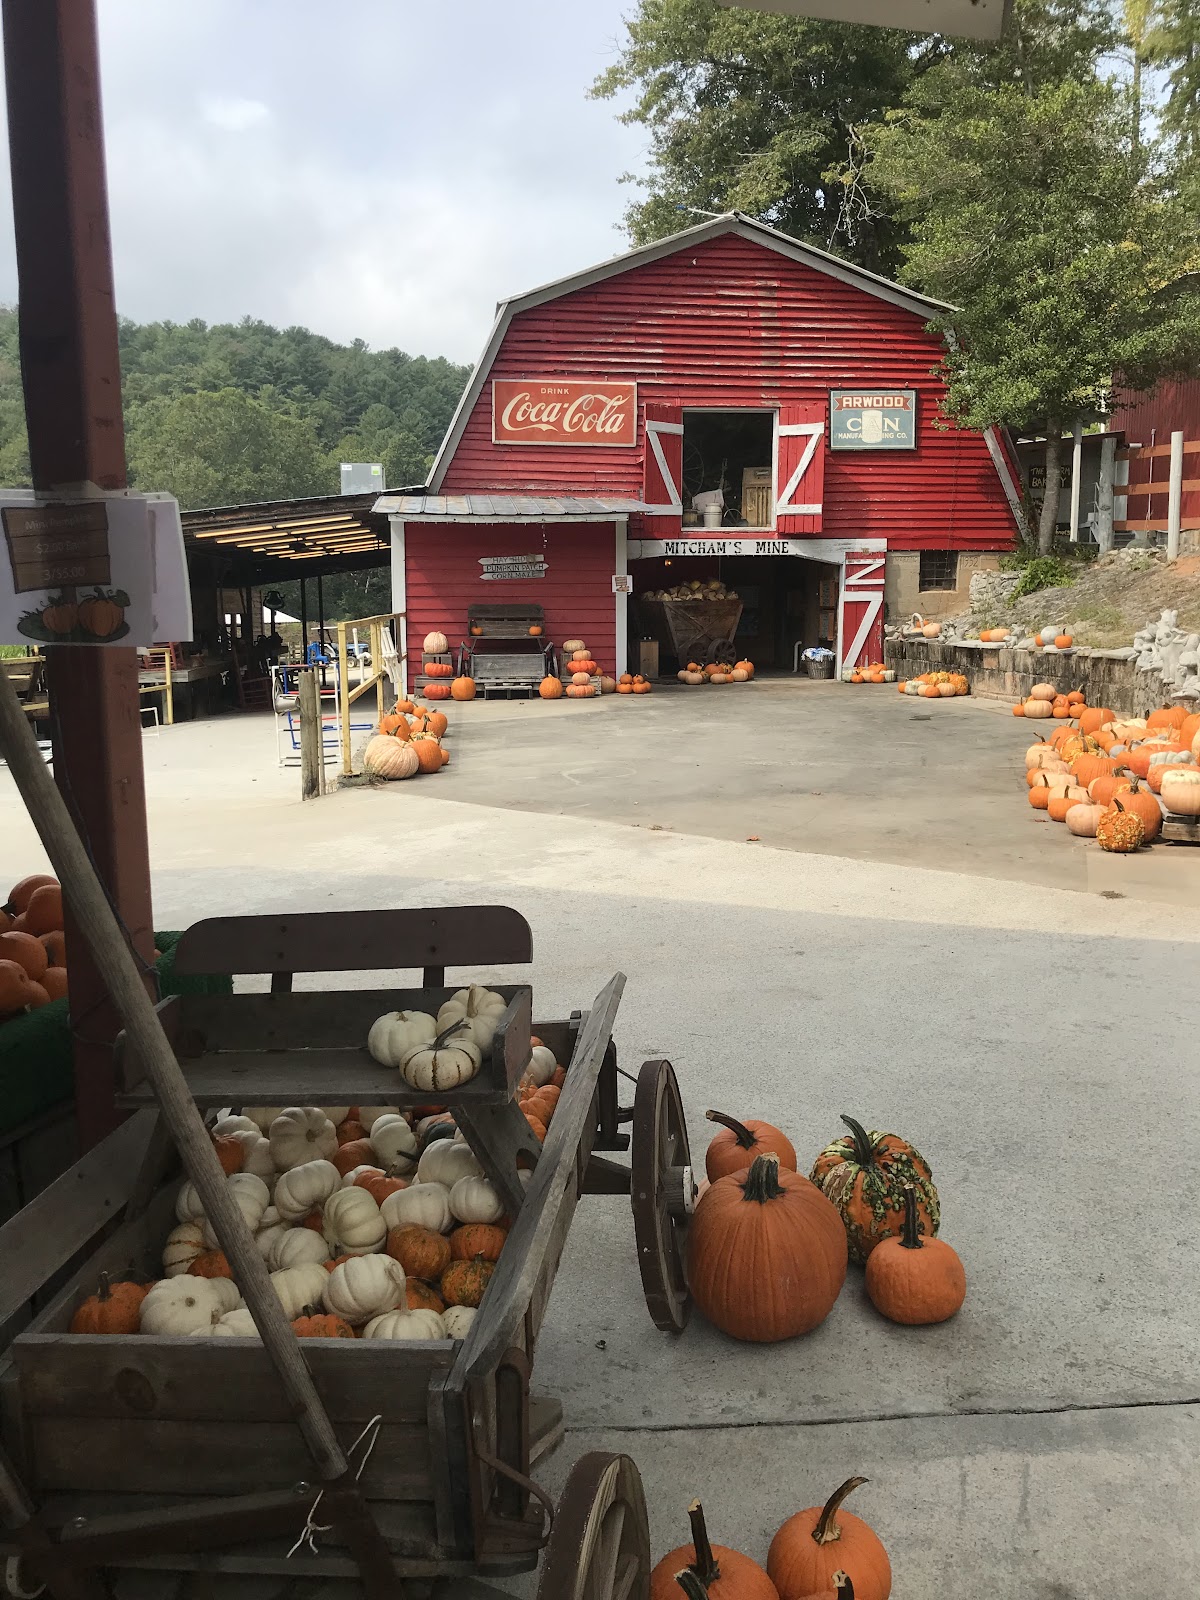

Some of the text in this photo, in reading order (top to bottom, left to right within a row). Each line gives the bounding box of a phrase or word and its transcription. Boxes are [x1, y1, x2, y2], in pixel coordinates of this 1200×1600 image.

[540, 387, 570, 395] DRINK
[842, 396, 904, 408] ARWOOD
[501, 392, 631, 433] Coca-Cola
[846, 417, 901, 432] CAN
[1031, 467, 1045, 475] THE
[1032, 477, 1067, 488] BAKY
[664, 541, 789, 555] MITCHAM'S MINE
[492, 555, 528, 565] HAY RID
[486, 563, 544, 572] PUMPKIN PATCH
[492, 570, 536, 580] CORN MAZE
